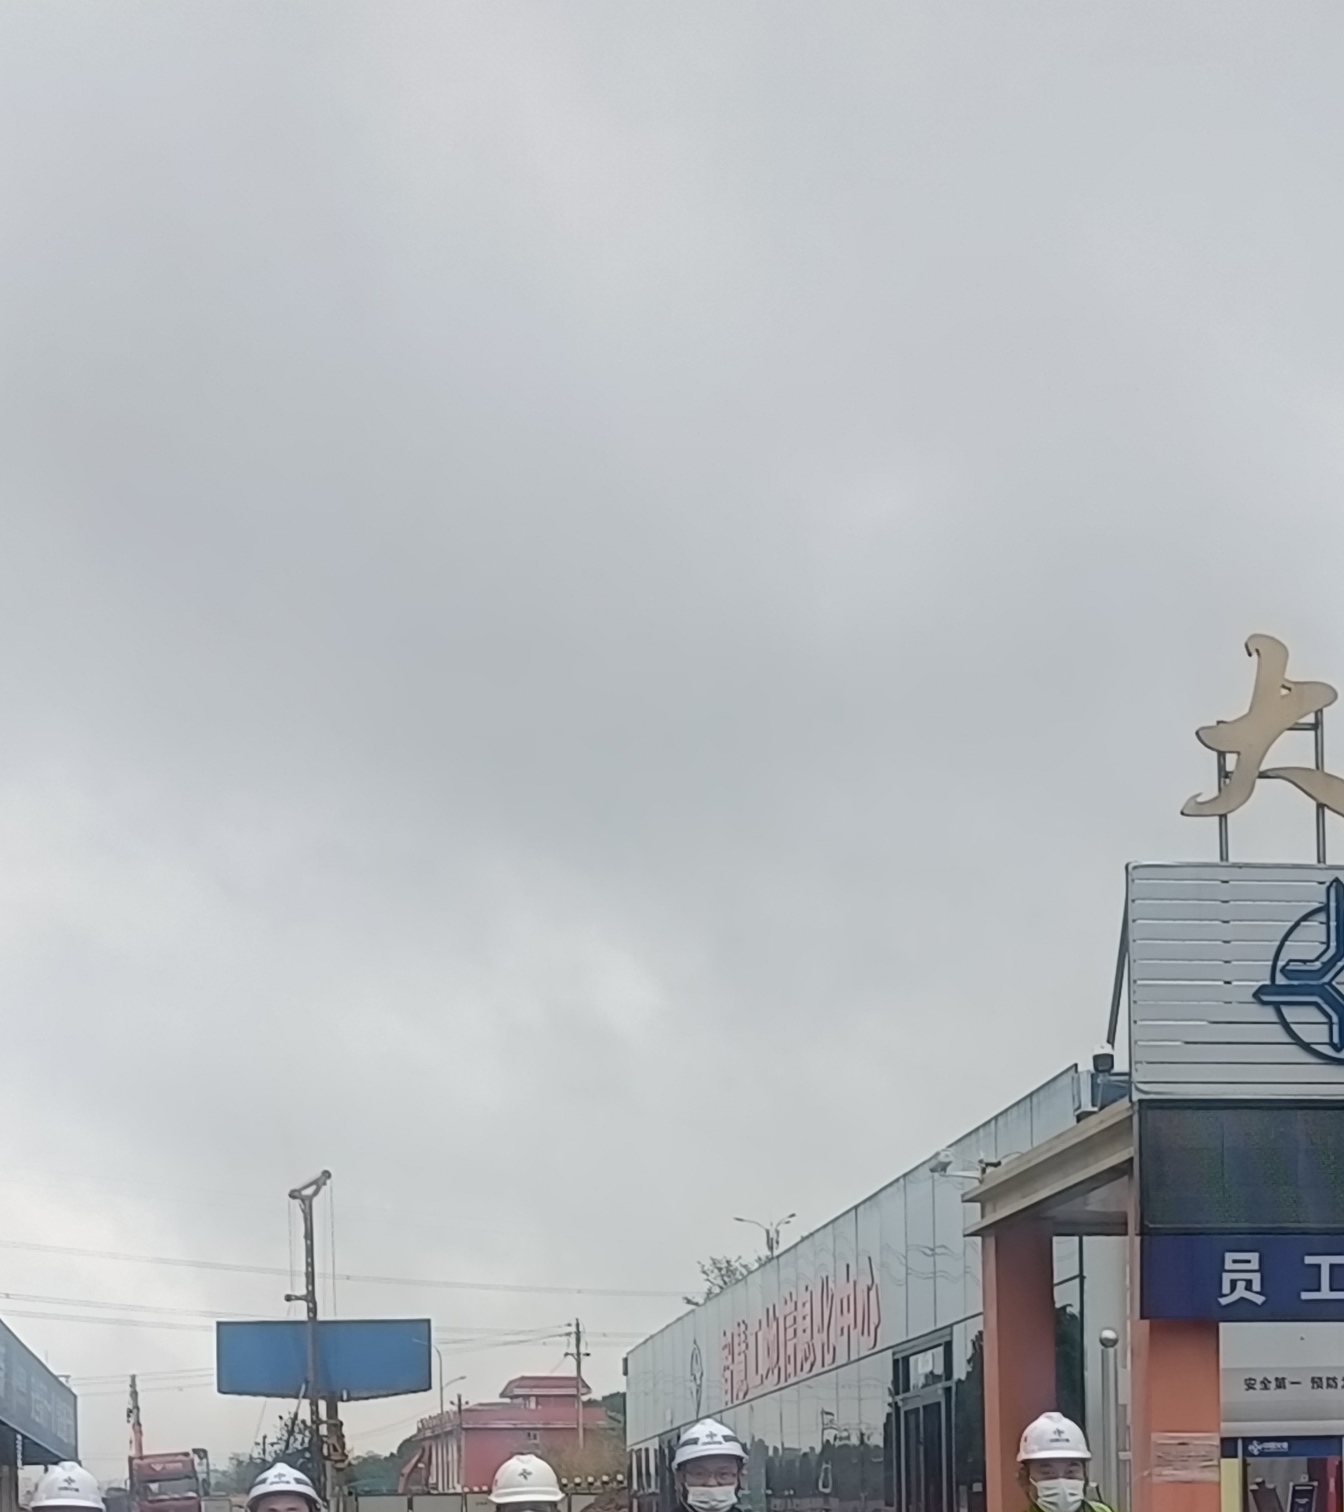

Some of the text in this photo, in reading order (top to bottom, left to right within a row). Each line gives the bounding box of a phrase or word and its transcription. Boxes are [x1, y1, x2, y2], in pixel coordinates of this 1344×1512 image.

[722, 1256, 880, 1406] 智慧工地信息化中心
[1244, 1375, 1302, 1392] 安全第一
